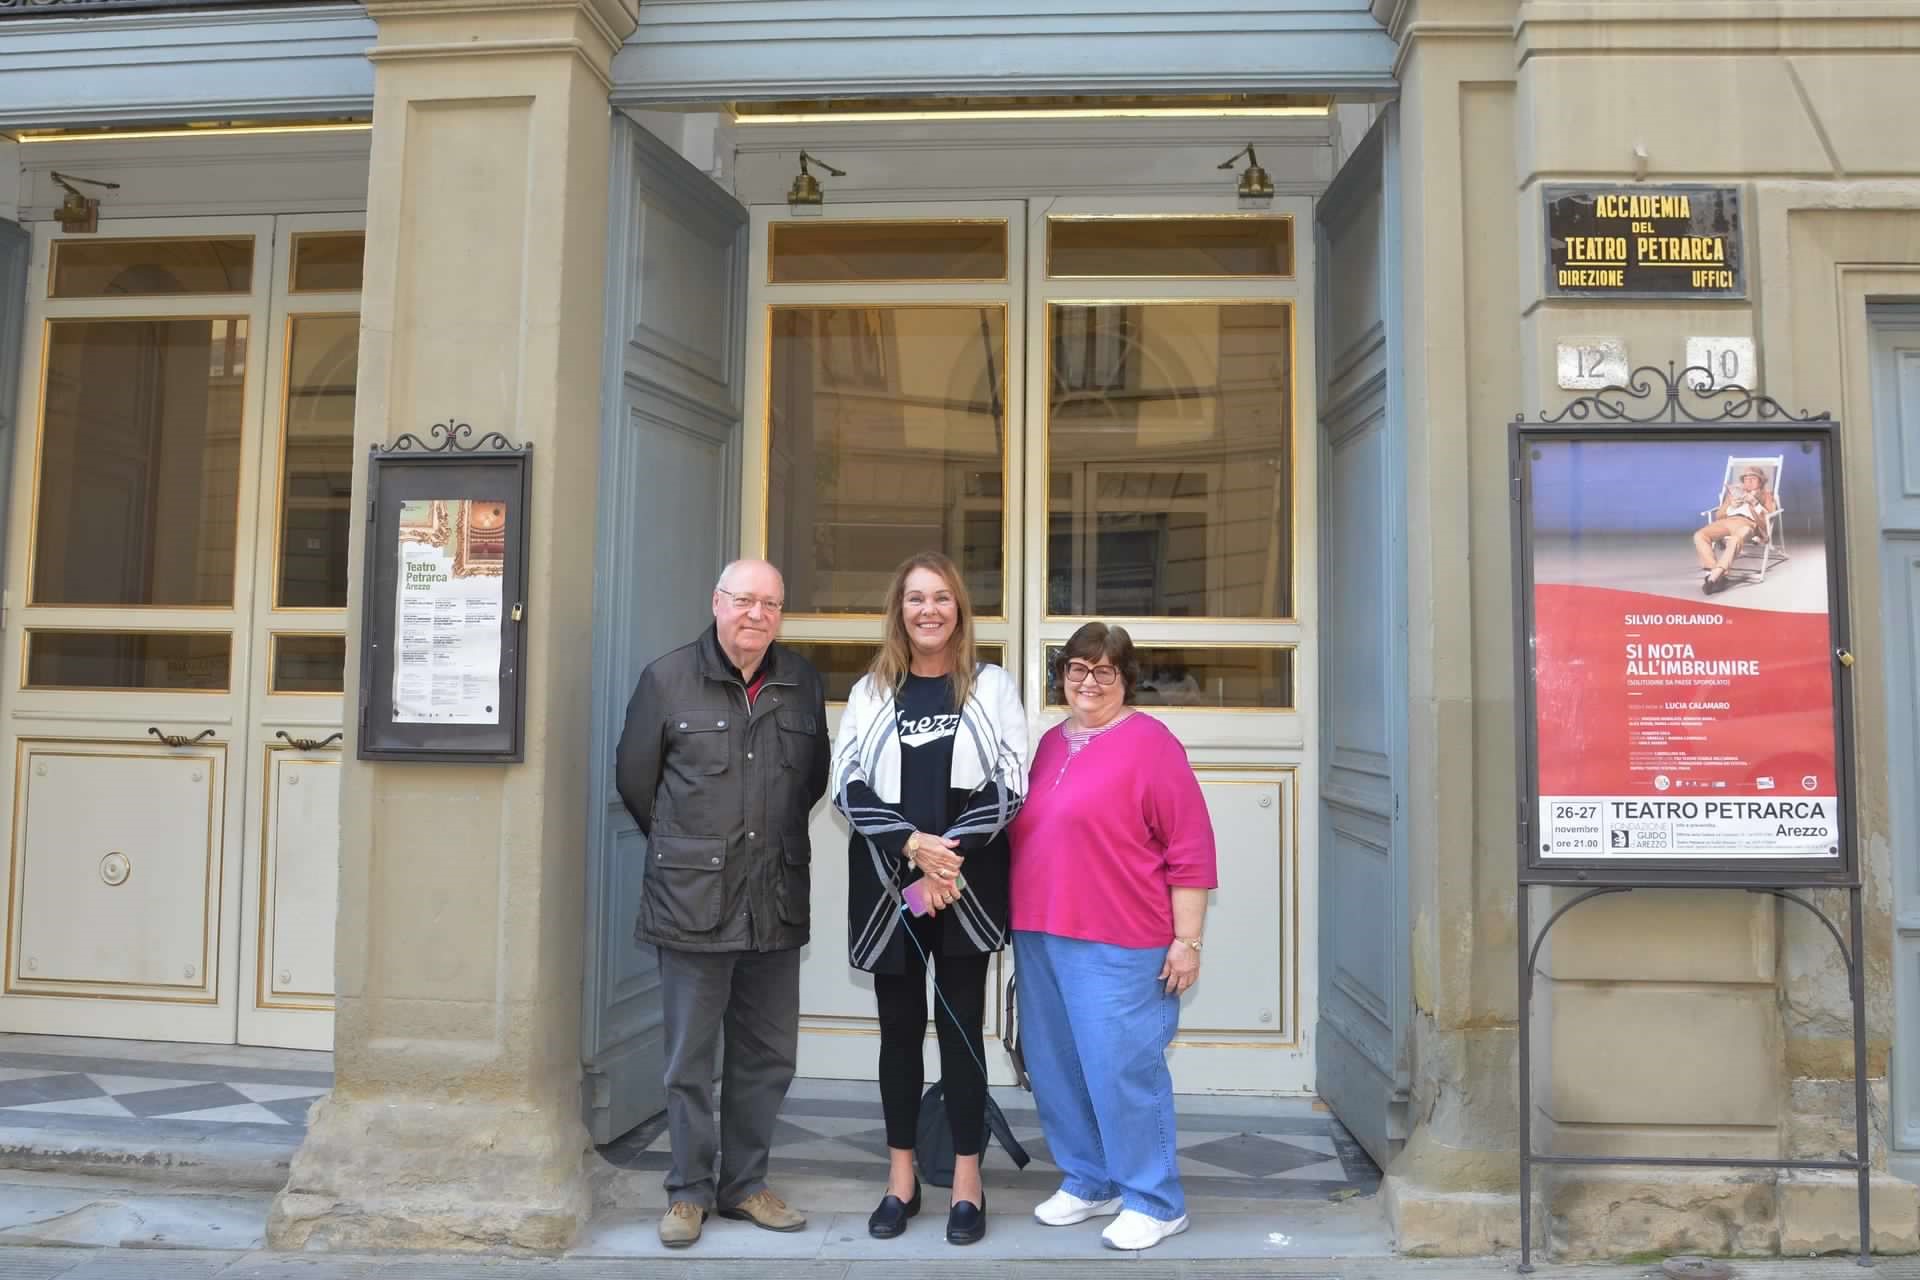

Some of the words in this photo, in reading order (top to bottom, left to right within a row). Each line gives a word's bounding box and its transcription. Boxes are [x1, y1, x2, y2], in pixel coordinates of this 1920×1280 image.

[1596, 195, 1691, 218] ACCADEMIA
[1631, 222, 1655, 233] DEL
[1565, 237, 1628, 260] TEATRO
[1637, 237, 1725, 261] PETRARCA
[1558, 270, 1625, 287] DIREZIONE
[1691, 270, 1733, 288] UFFICI
[1576, 349, 1606, 378] 12
[1705, 349, 1740, 379] 10
[406, 562, 436, 571] Teatro
[406, 572, 448, 582] Petrarca
[1624, 614, 1663, 625] SILVIO
[1665, 614, 1723, 625] ORLANDO
[1625, 644, 1643, 659] SI
[1648, 644, 1695, 659] NOTA
[1626, 659, 1760, 676] ALL'IMBRUNIRE
[1664, 702, 1687, 710] LUCIA
[1688, 702, 1730, 710] CALAMARO
[897, 710, 960, 737] rezz
[1556, 806, 1597, 819] 26-27
[1611, 802, 1698, 819] TEATRO
[1705, 802, 1826, 819] PETRARCA
[1555, 825, 1599, 833] novembre
[1636, 831, 1667, 840] GUIDO
[1775, 824, 1828, 837] Arezzo
[1574, 840, 1598, 848] 21.00
